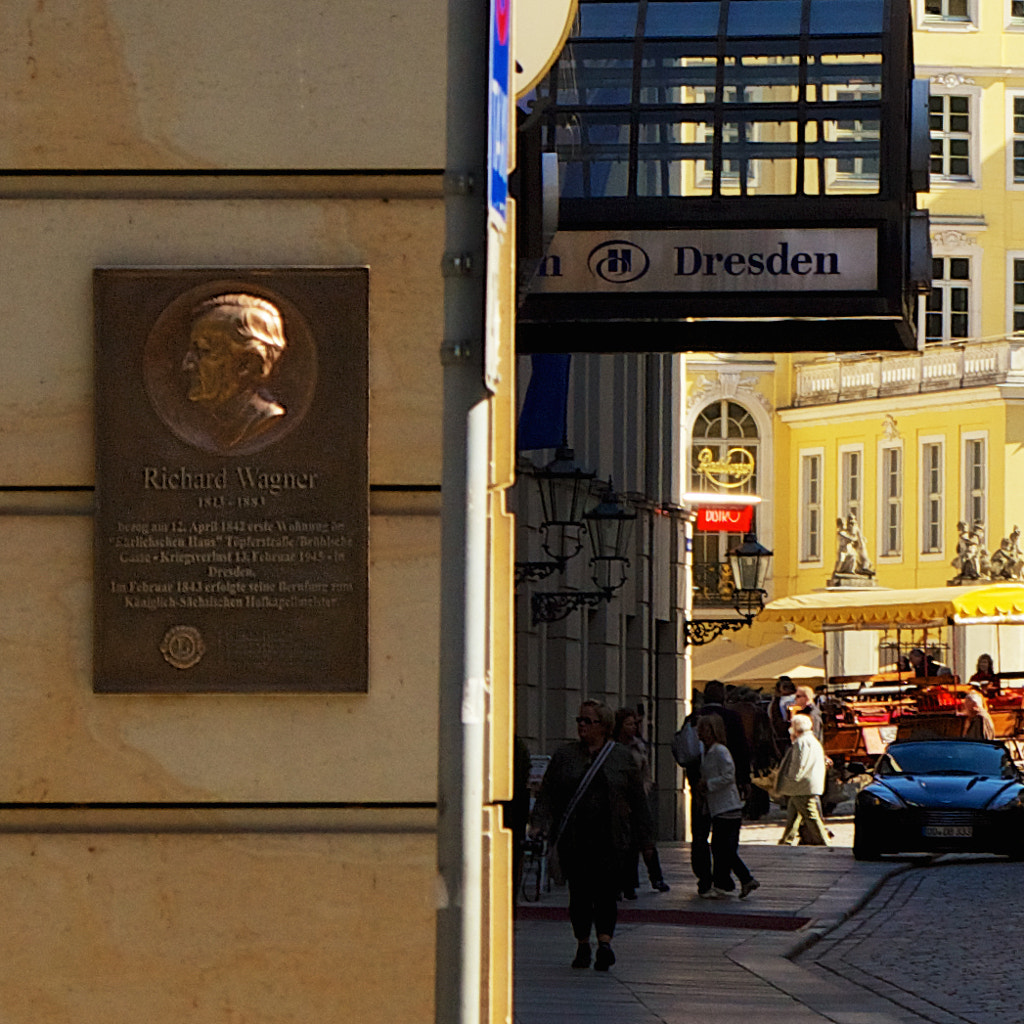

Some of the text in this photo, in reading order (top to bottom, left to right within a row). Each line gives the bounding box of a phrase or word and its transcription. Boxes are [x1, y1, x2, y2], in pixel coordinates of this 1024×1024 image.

[674, 242, 841, 276] Dresden
[144, 466, 319, 495] Richard Wagner
